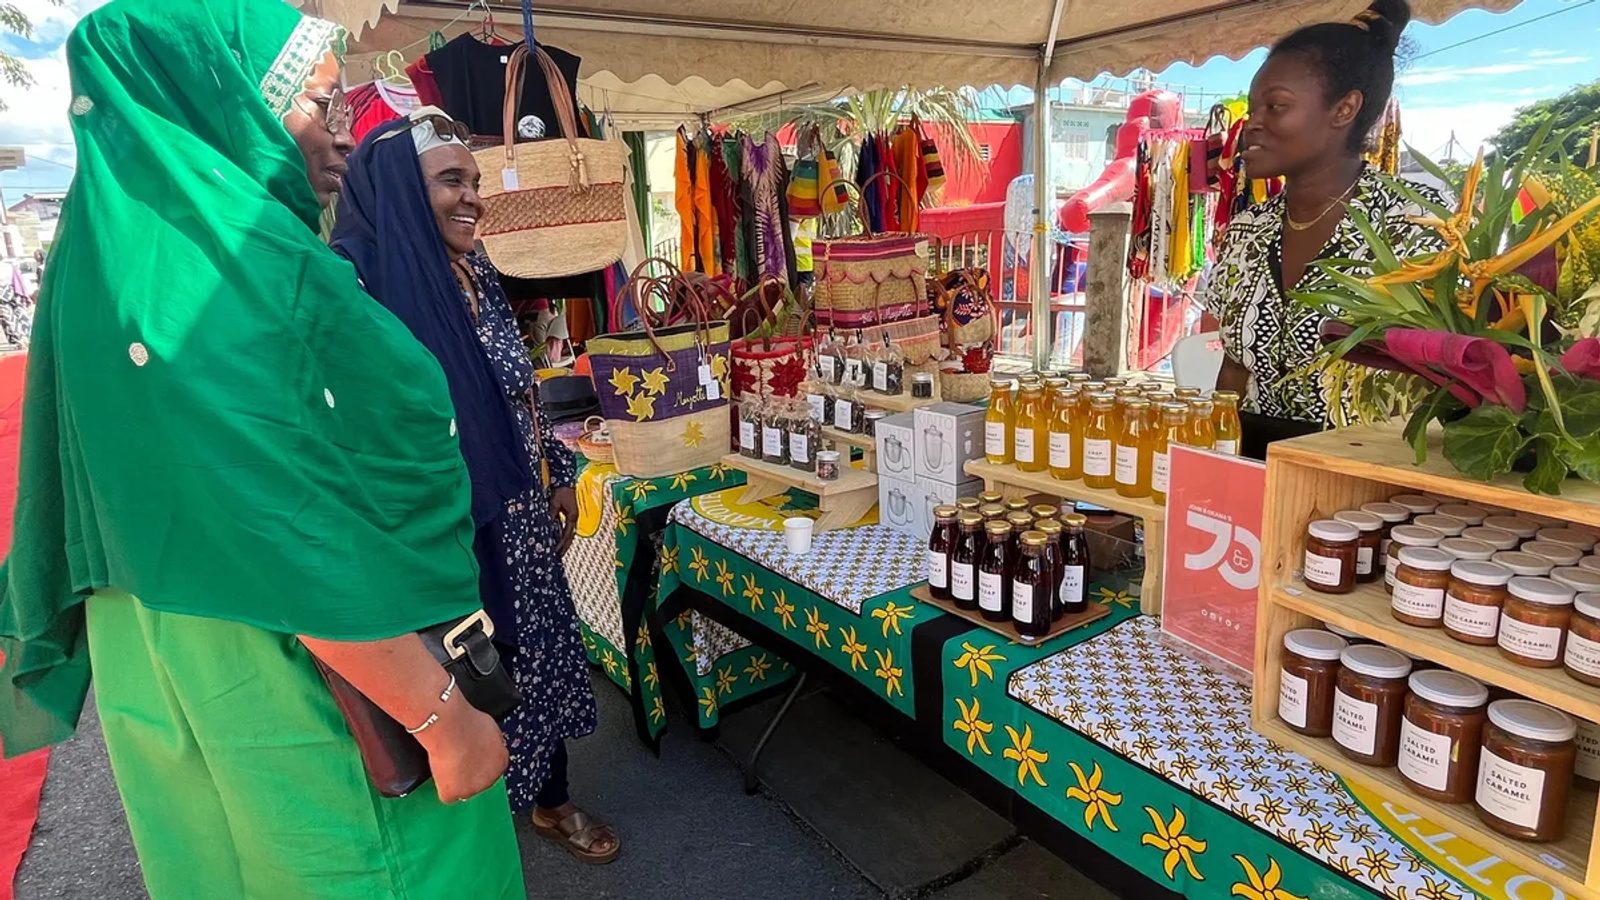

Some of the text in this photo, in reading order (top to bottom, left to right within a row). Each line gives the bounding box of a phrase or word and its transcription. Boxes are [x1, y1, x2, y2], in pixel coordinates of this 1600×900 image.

[1460, 616, 1491, 627] CARAMEL
[1517, 639, 1553, 649] CARAMEL
[1336, 712, 1368, 732] CARAMEL
[1338, 704, 1365, 722] SALTED
[1406, 736, 1437, 755] SALTED
[1575, 733, 1599, 746] LTED
[1403, 743, 1440, 766] CARAMEL
[1577, 744, 1600, 757] AMEL
[1490, 769, 1528, 791] SALTED
[1485, 777, 1532, 802] CARAMEL
